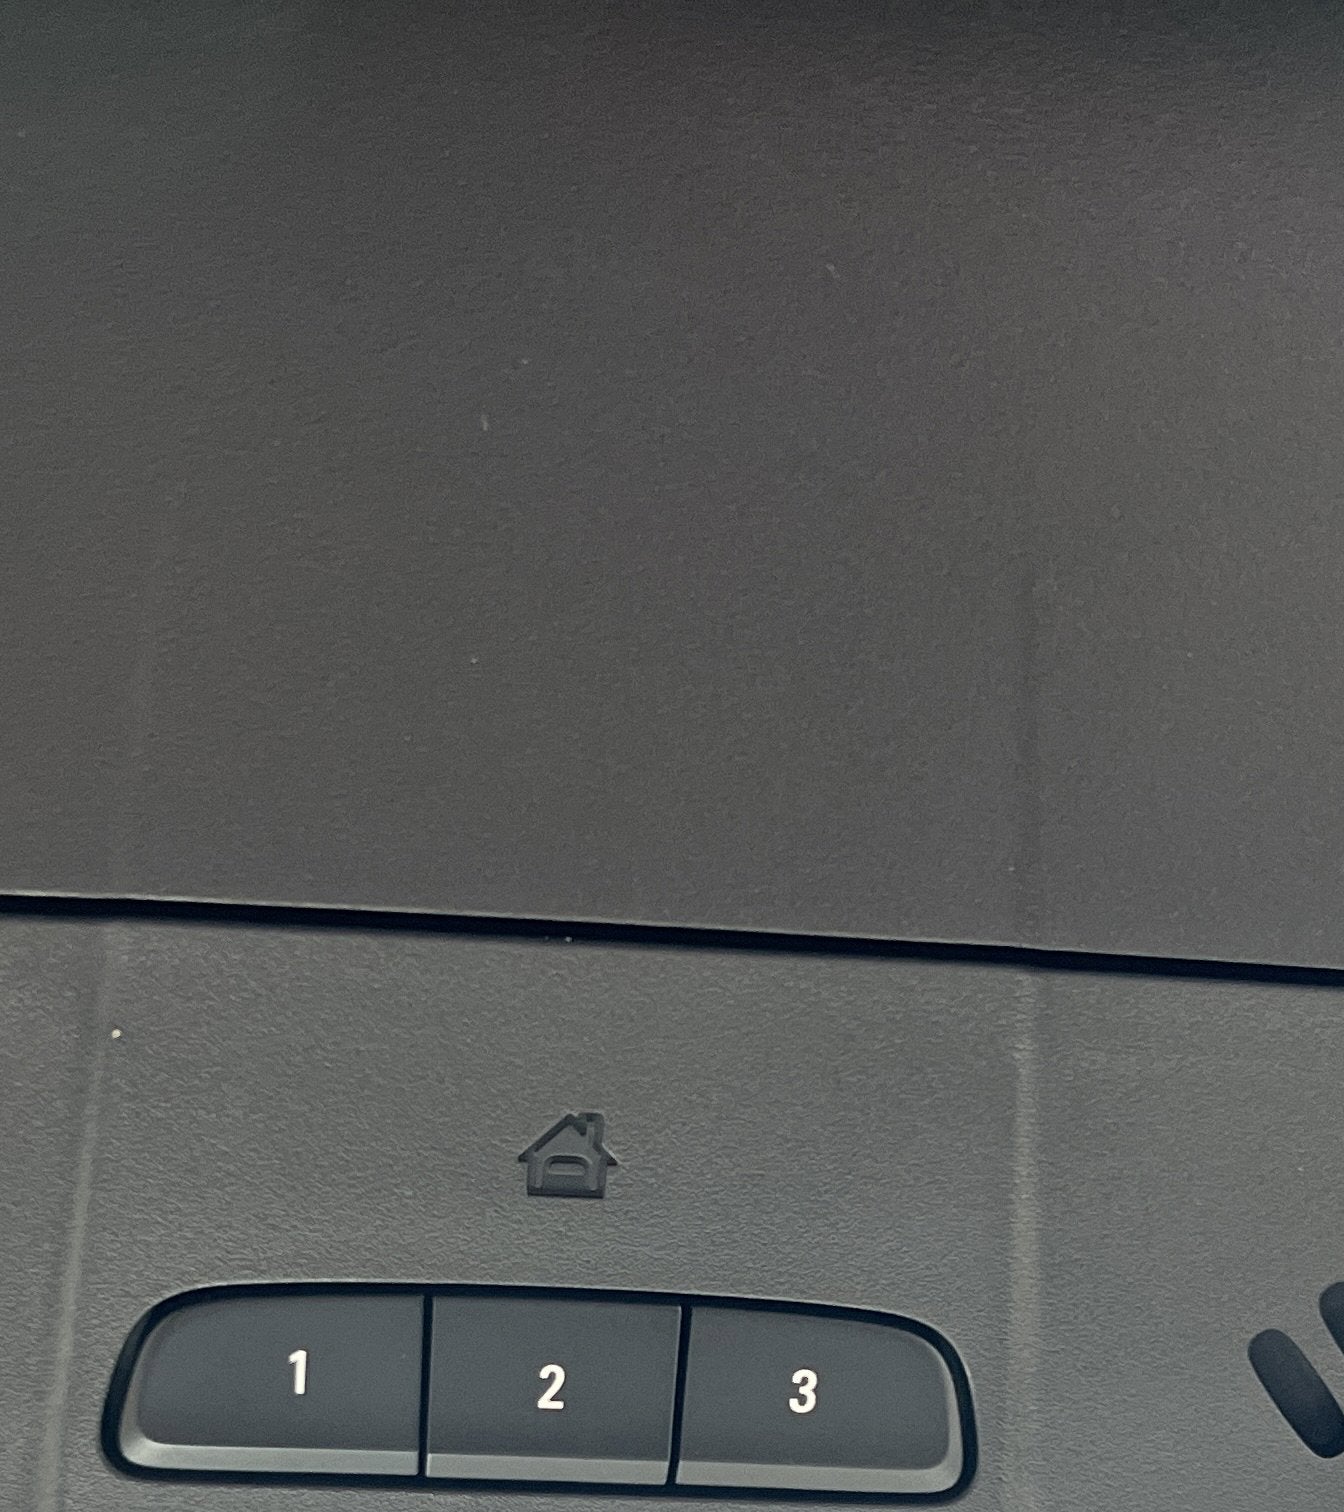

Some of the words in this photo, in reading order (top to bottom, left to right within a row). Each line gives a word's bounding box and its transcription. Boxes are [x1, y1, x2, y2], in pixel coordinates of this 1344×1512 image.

[287, 1348, 308, 1396] 1
[536, 1362, 567, 1411] 2
[787, 1367, 819, 1415] 3
